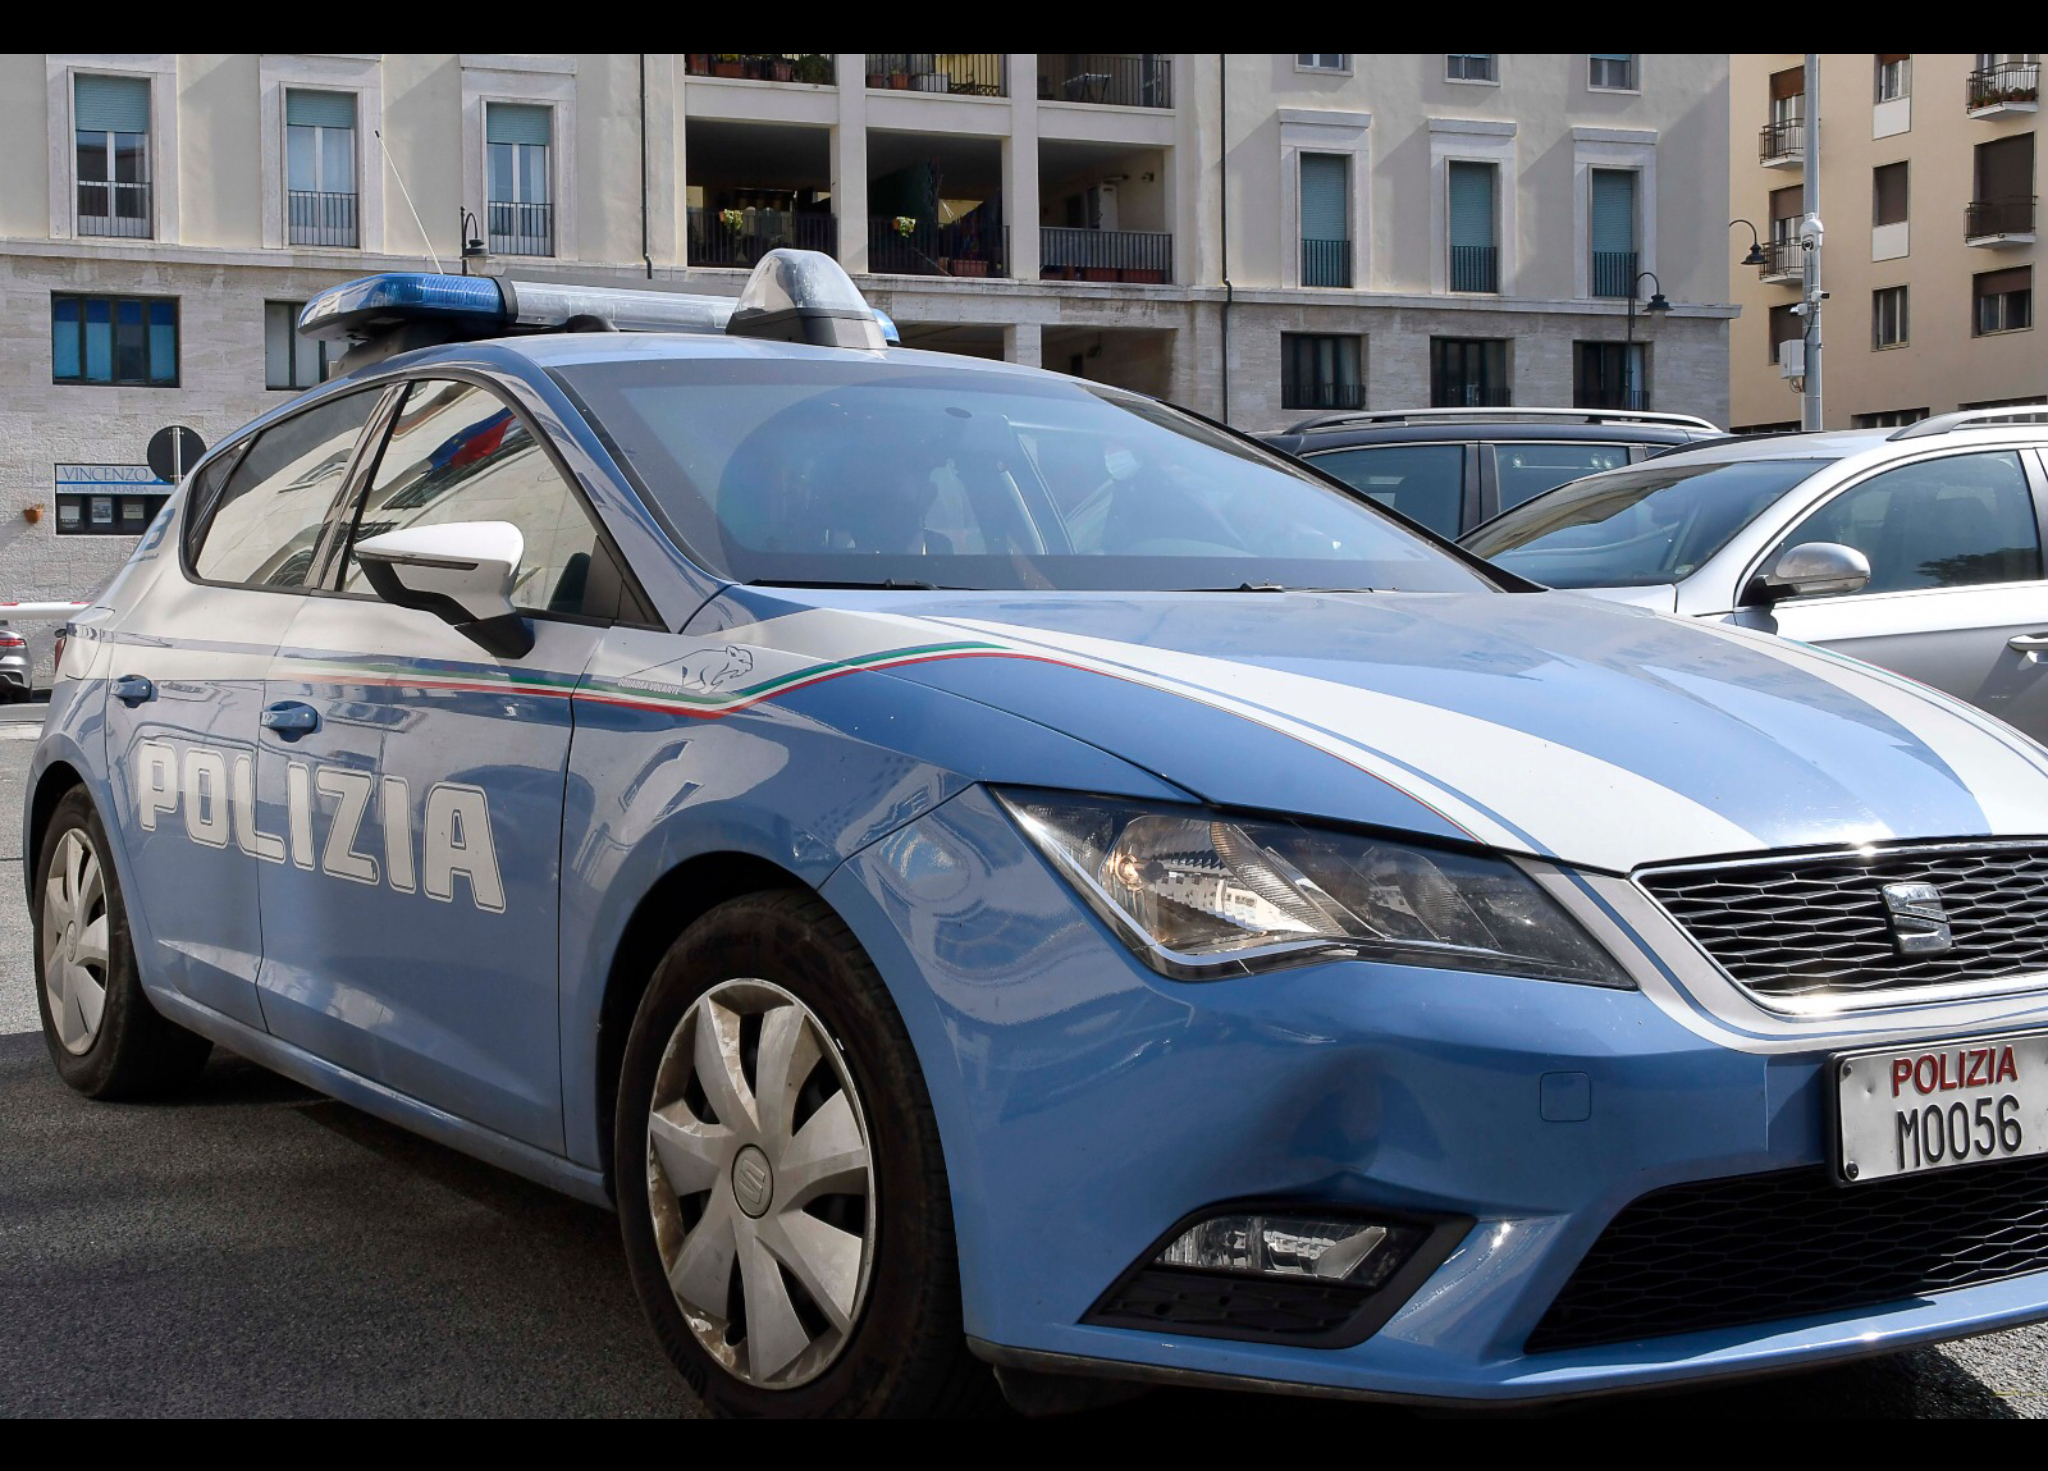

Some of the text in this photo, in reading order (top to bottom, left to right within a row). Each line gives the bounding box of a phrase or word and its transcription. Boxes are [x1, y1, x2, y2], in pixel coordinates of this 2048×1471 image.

[64, 467, 148, 481] VINCENZO
[138, 740, 506, 914] POLIZIA
[1892, 1045, 2018, 1097] POLIZIA
[1896, 1095, 2021, 1170] M0056
